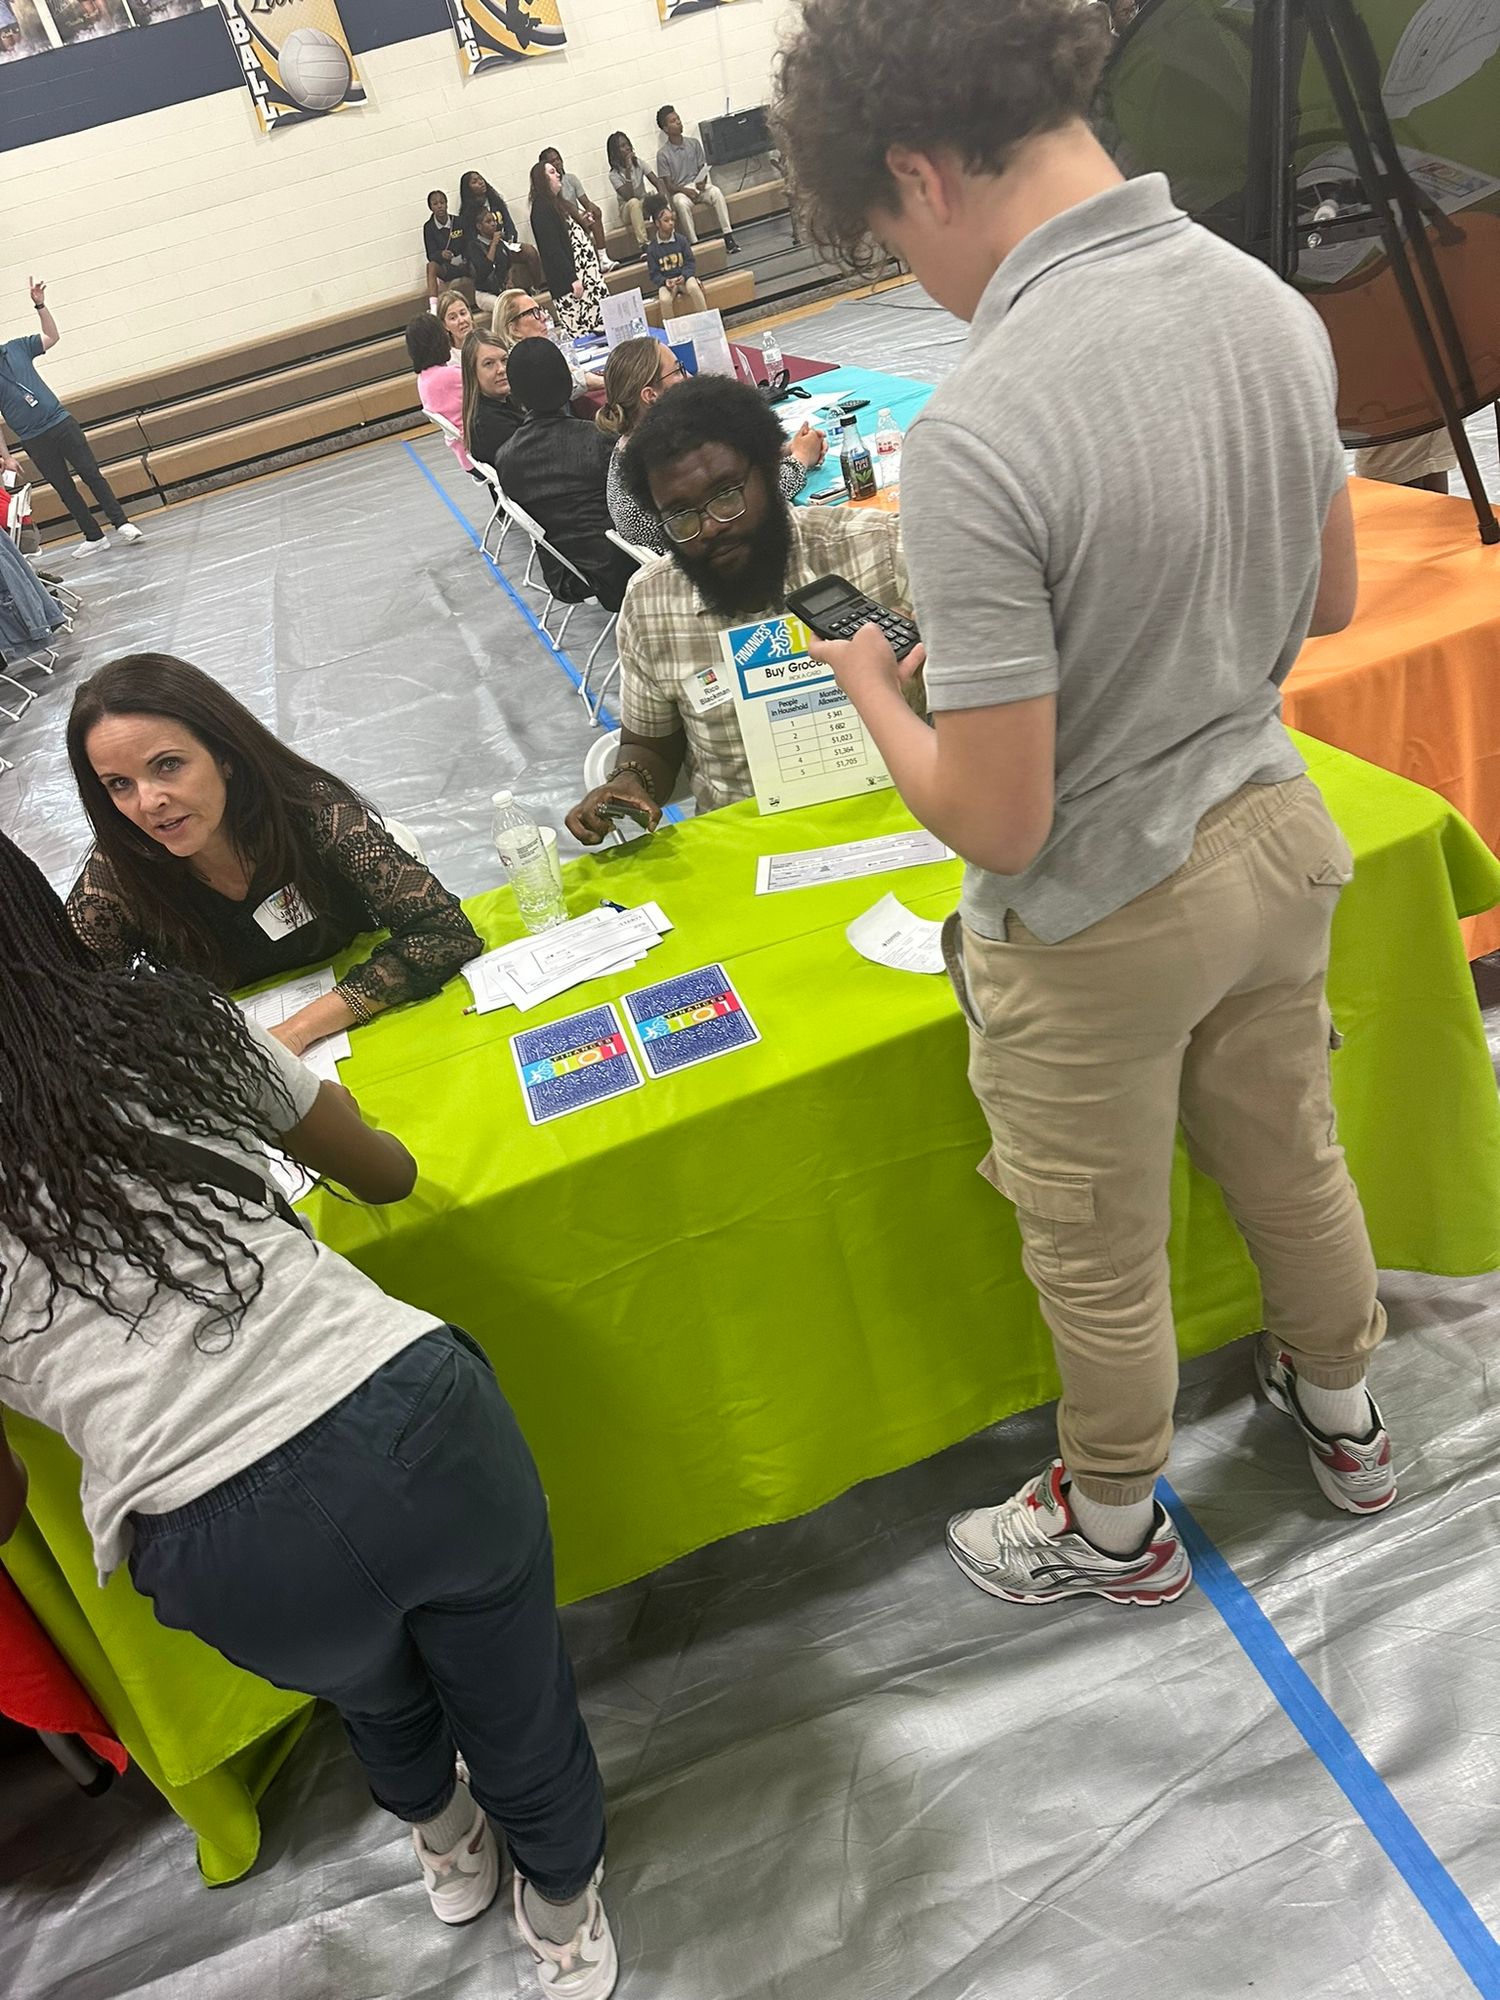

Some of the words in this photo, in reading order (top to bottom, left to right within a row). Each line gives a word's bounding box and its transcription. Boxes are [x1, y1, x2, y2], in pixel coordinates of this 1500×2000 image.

[734, 623, 772, 666] FINANCES
[765, 666, 785, 679] Buy
[704, 685, 720, 695] Rico
[819, 688, 843, 699] Monthly
[699, 688, 731, 706] Blackman
[778, 698, 798, 708] People
[777, 702, 809, 714] Household
[832, 733, 853, 744] $1,023
[834, 746, 854, 756] $1,364
[836, 758, 858, 768] $1,705
[667, 996, 725, 1019] FINANCES
[673, 1000, 733, 1029] 101
[553, 1038, 612, 1062] FINANCES
[558, 1042, 618, 1073] 101
